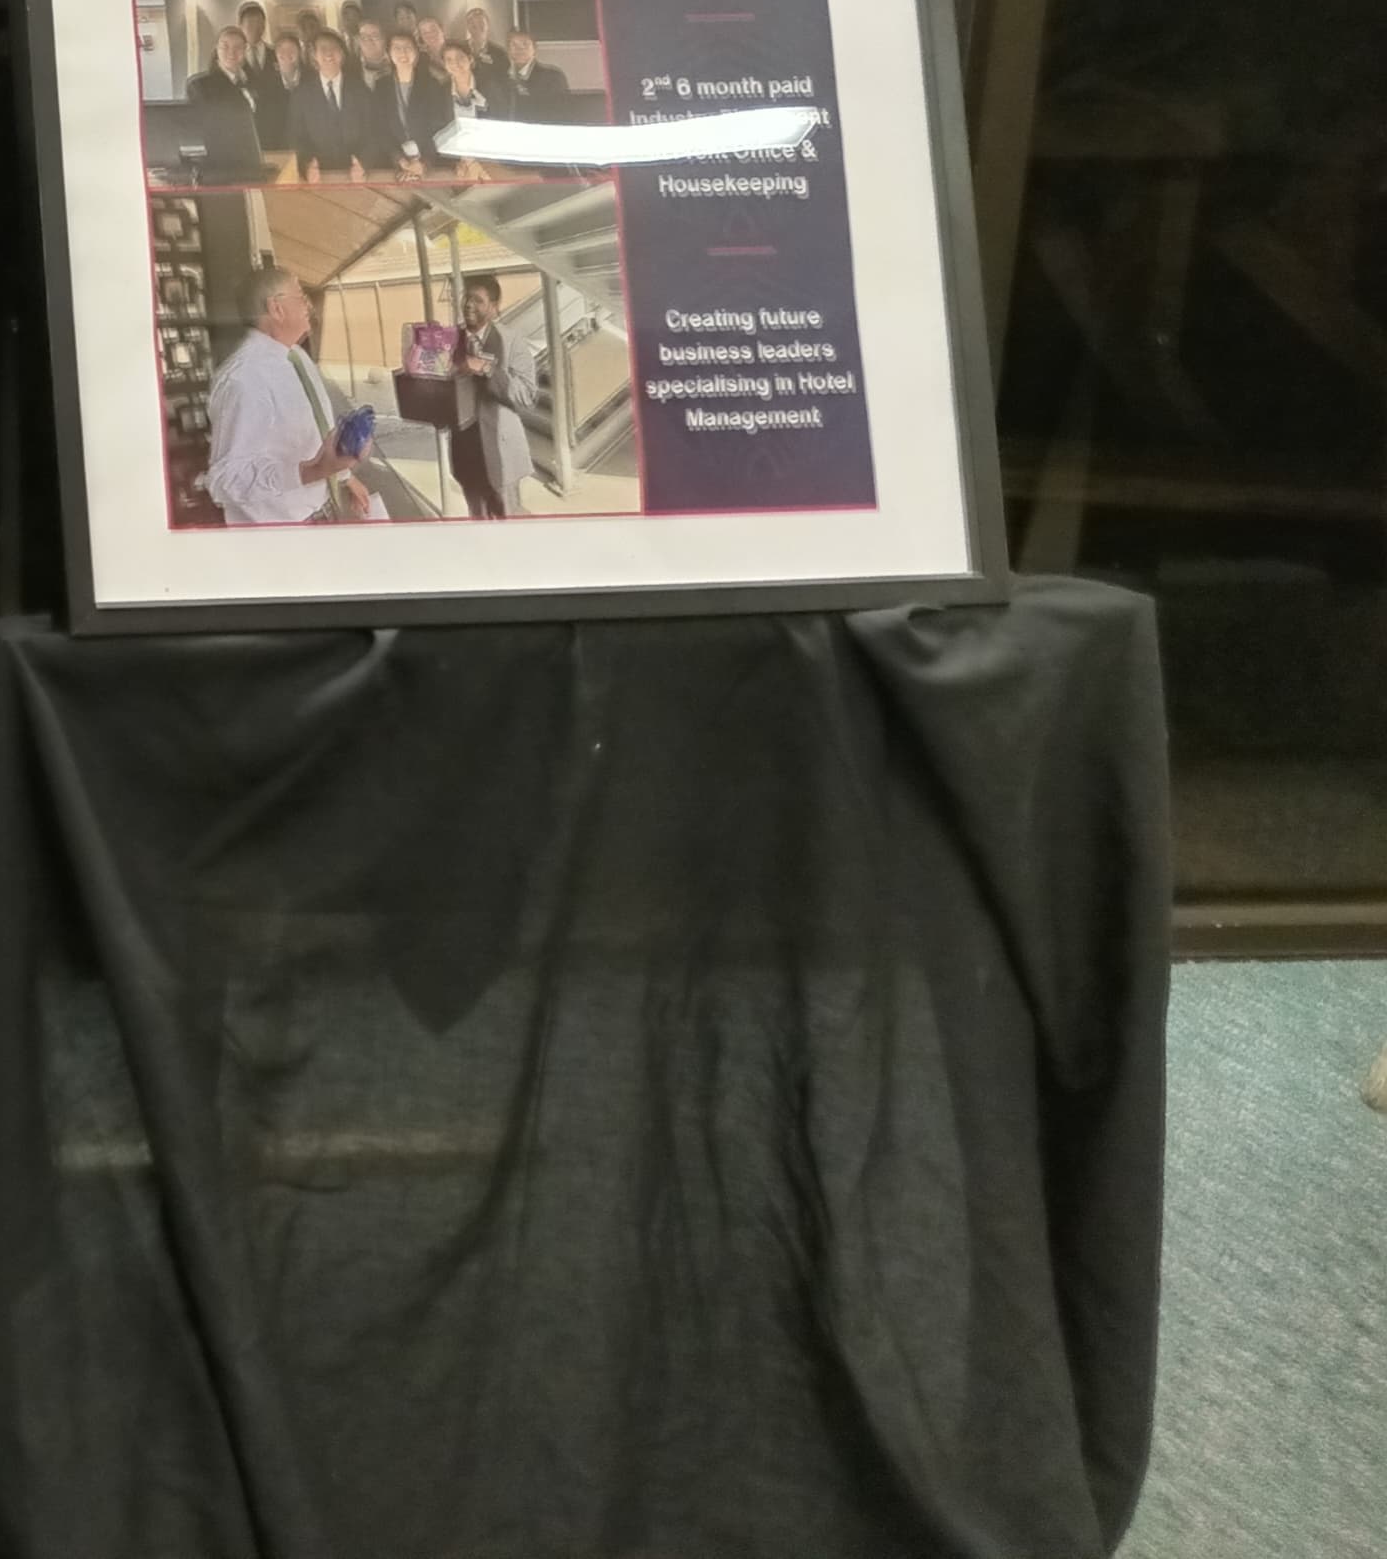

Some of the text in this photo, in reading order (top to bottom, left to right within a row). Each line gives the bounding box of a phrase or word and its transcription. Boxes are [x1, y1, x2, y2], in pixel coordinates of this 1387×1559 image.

[676, 77, 692, 98] 6
[697, 76, 763, 98] month
[768, 76, 814, 102] paid
[801, 139, 818, 161] &
[658, 175, 808, 200] Housekeeping
[665, 308, 822, 334] Creating future
[659, 342, 835, 366] business leaders
[645, 372, 857, 402] specialising in Hotel
[685, 407, 822, 434] Management
